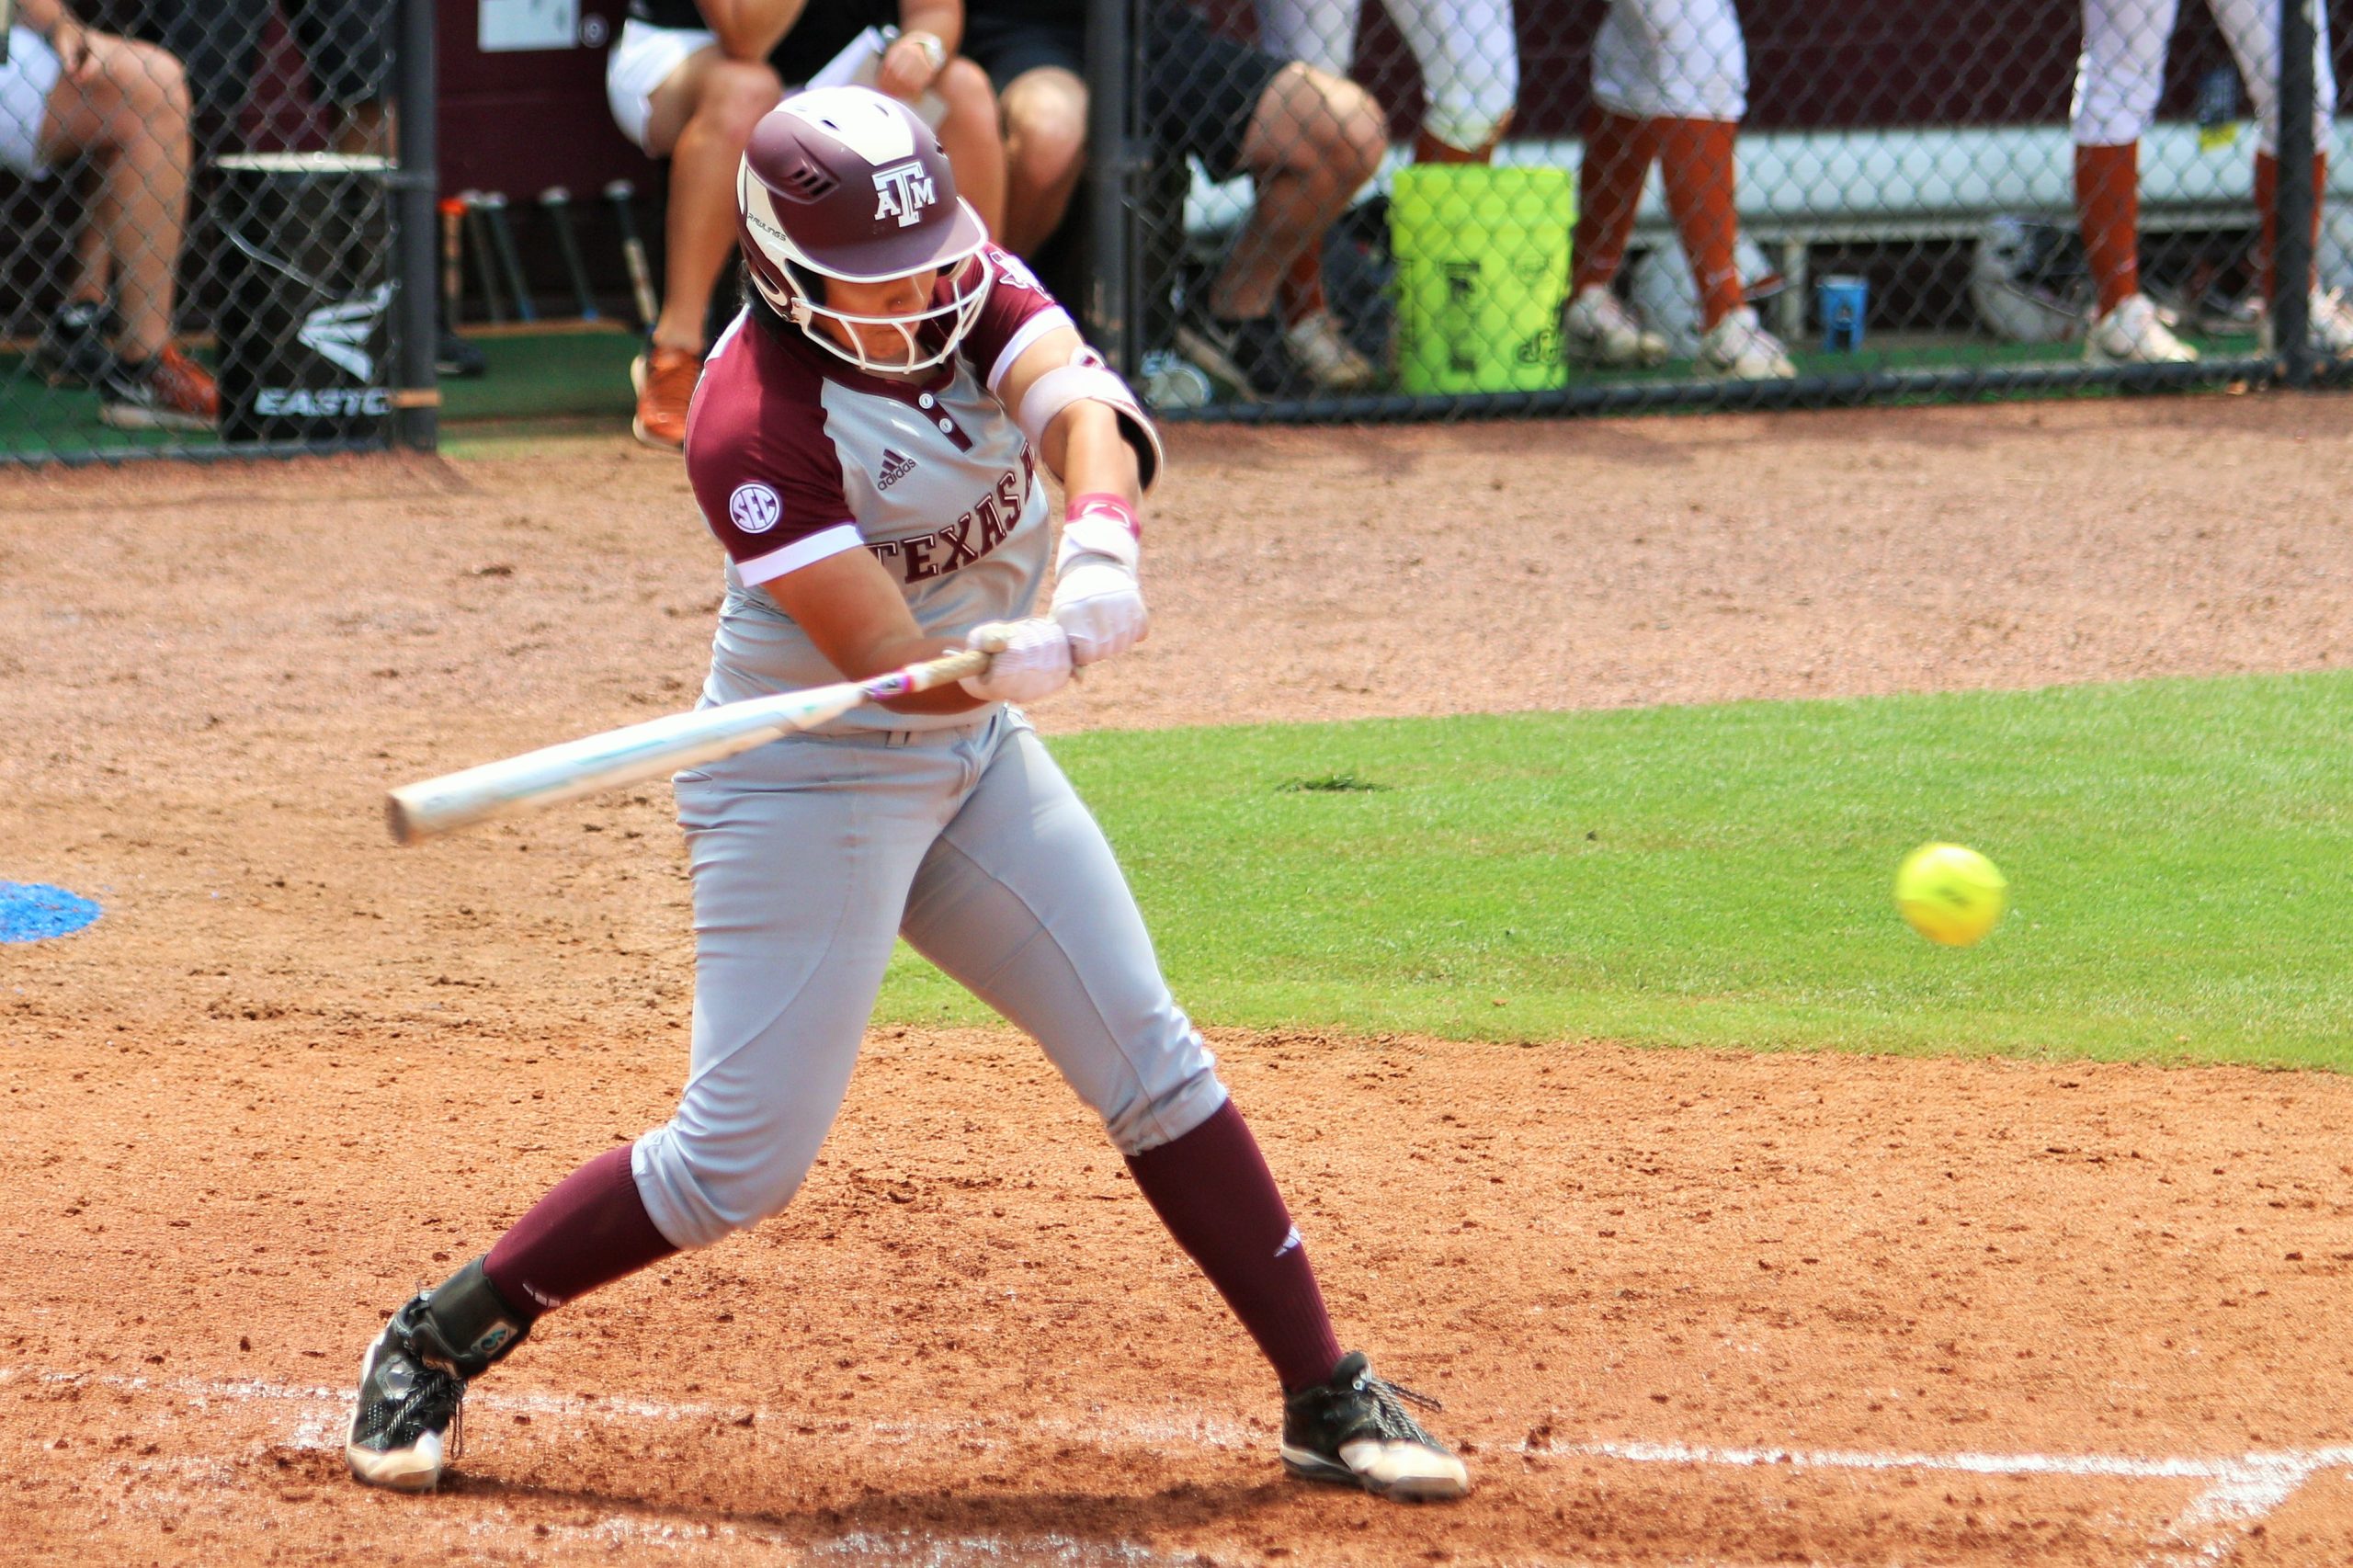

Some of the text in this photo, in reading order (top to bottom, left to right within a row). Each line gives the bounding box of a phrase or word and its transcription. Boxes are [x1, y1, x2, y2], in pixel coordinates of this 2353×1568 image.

[747, 212, 788, 242] RAWLINGS
[877, 458, 916, 491] adidas
[732, 486, 777, 531] SEC
